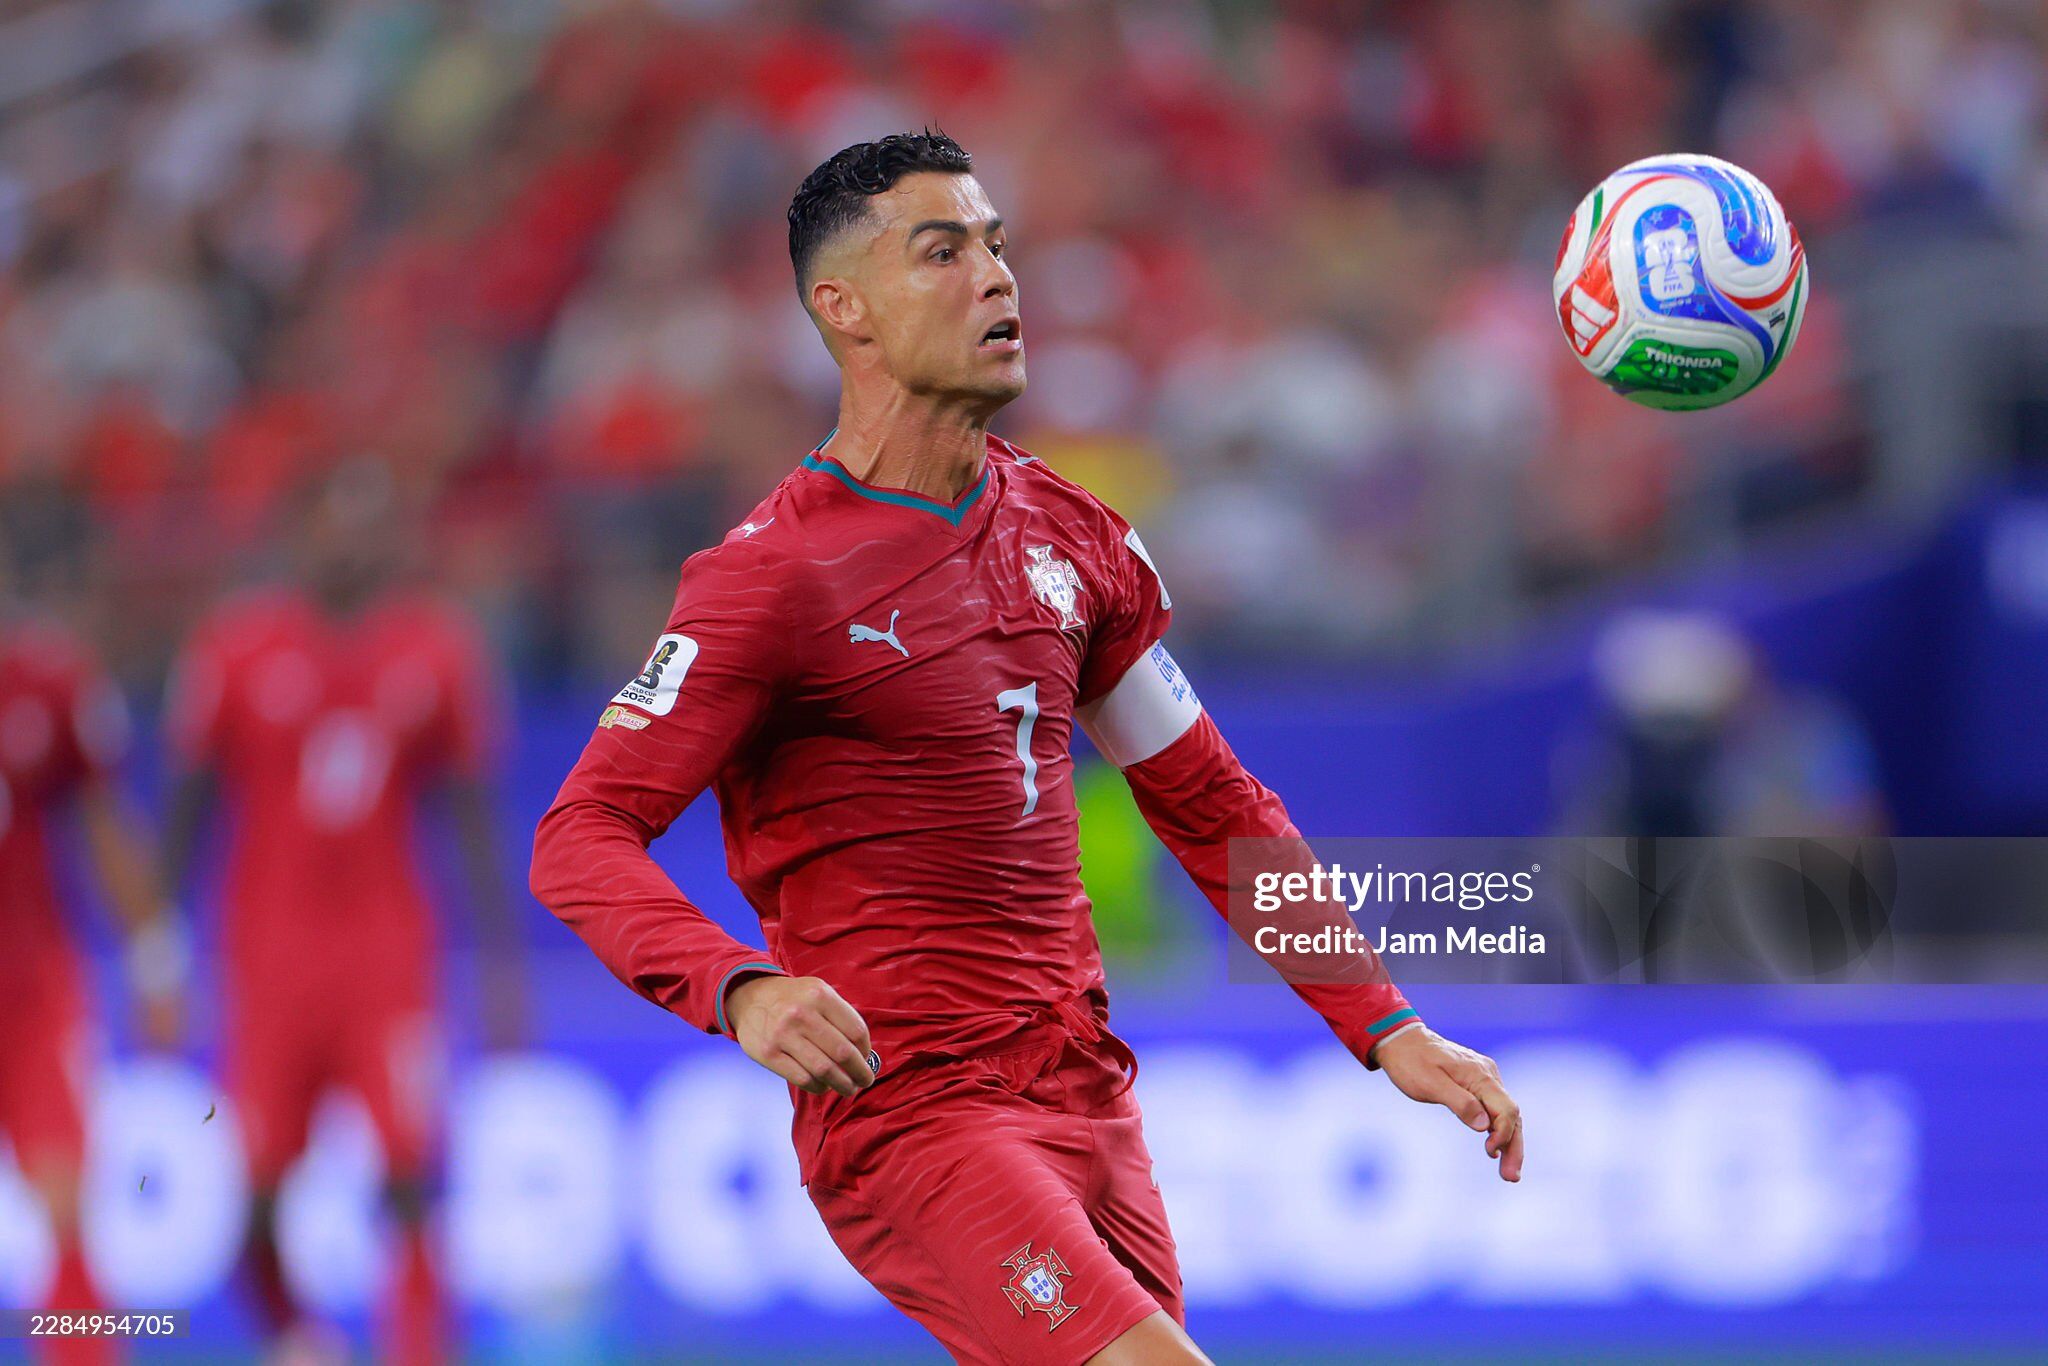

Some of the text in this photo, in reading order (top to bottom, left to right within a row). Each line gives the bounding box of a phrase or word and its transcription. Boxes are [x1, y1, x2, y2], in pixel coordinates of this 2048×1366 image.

[1663, 282, 1683, 294] FIFA
[1645, 346, 1723, 369] TRIONDA
[621, 689, 655, 705] 2026
[996, 681, 1039, 817] 7
